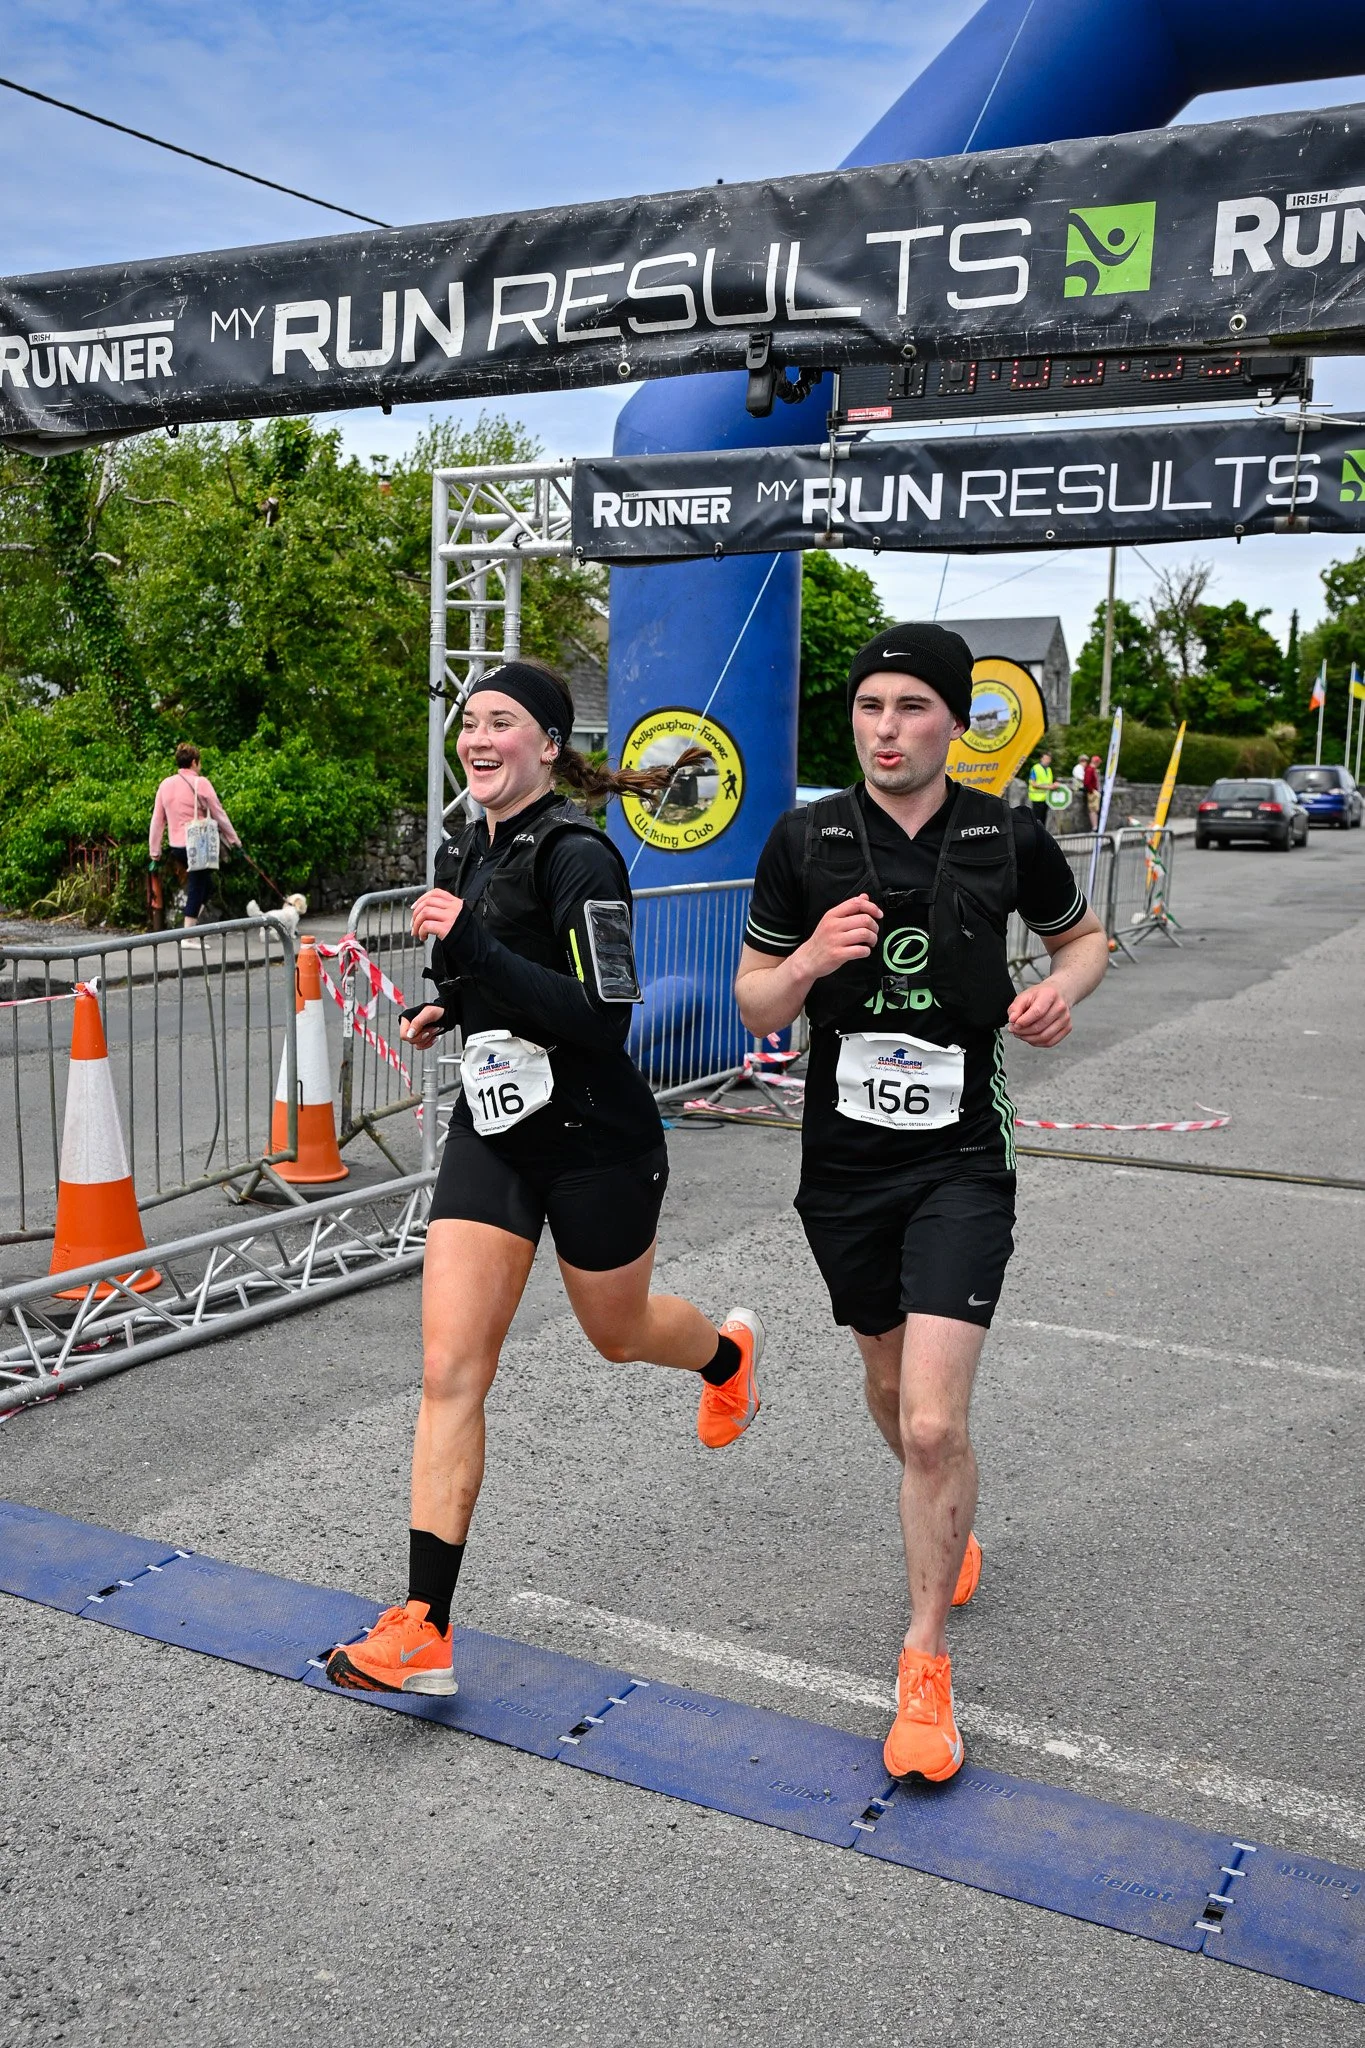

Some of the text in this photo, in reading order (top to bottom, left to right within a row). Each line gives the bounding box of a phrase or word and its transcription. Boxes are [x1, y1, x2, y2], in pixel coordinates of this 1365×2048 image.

[1292, 193, 1329, 206] IRISH
[210, 217, 1031, 375] MY RUN RESULTS
[31, 334, 51, 342] IRISH
[0, 335, 174, 388] RUNNER
[757, 453, 1321, 524] MY RUN RESULTS
[593, 492, 732, 529] RUNNER
[957, 761, 999, 773] Burren
[634, 813, 714, 848] Walking Club
[821, 827, 854, 839] FORZA
[960, 826, 1000, 838] FORZA
[478, 1082, 524, 1120] 116
[862, 1078, 930, 1115] 156
